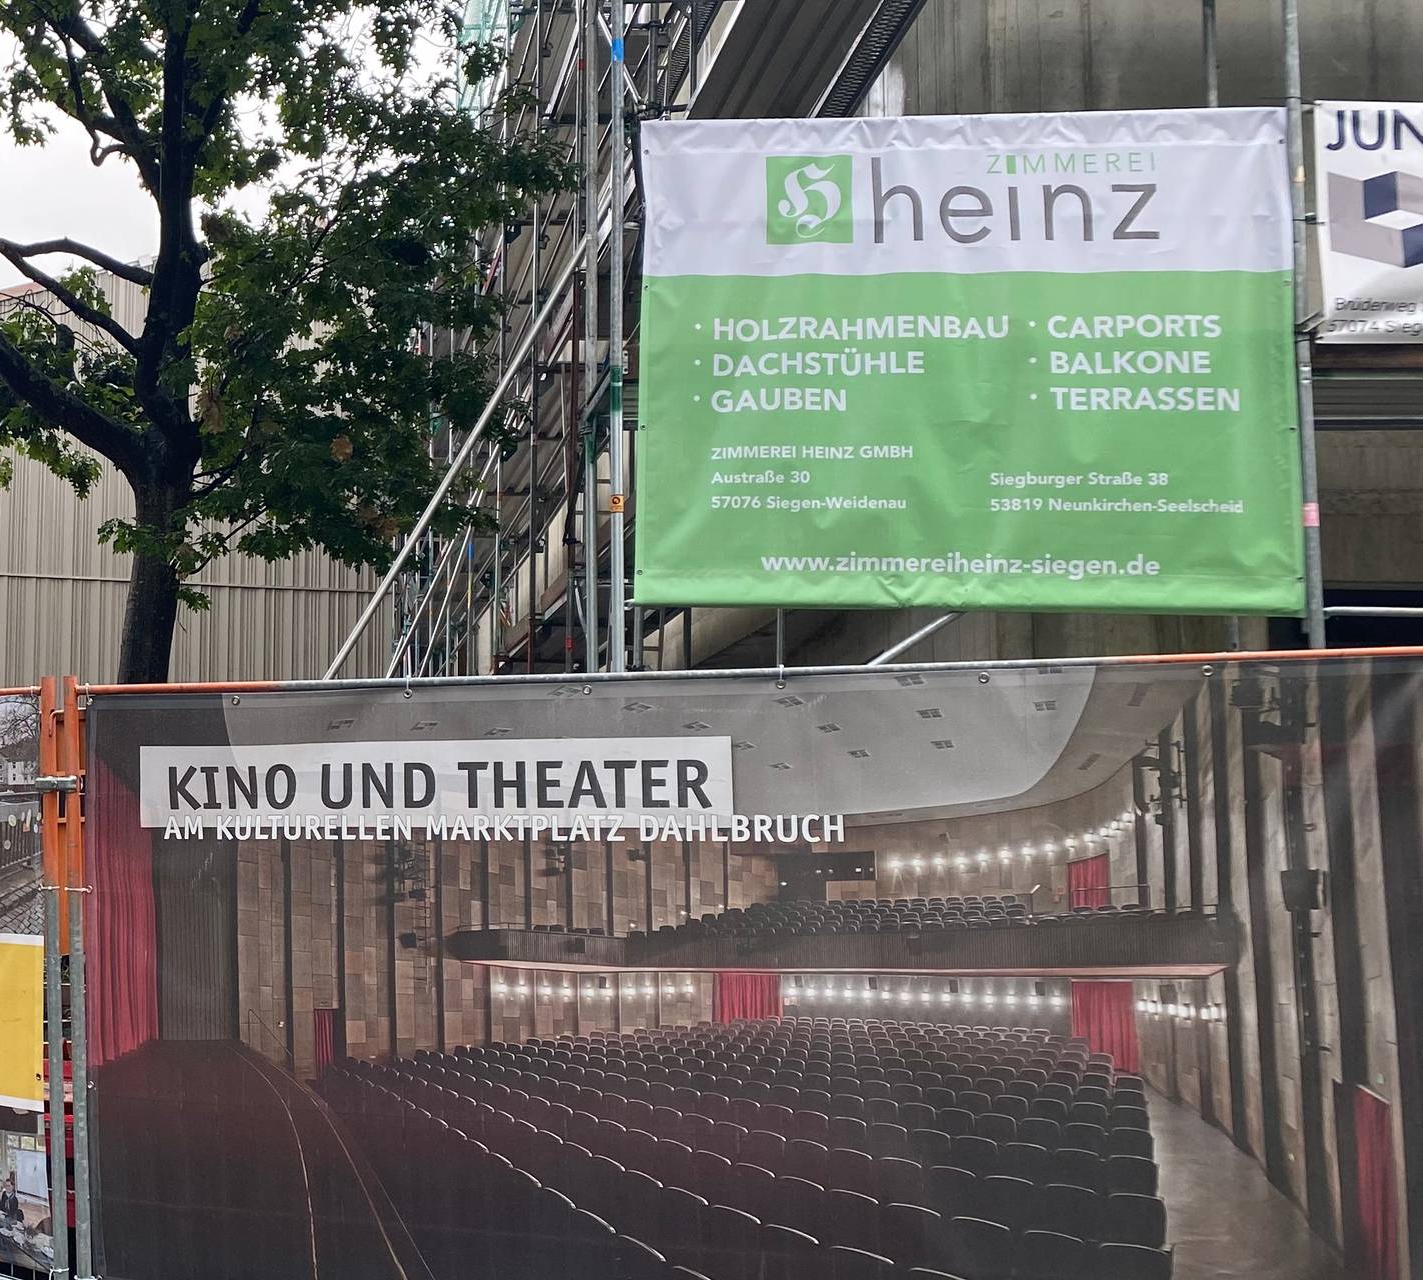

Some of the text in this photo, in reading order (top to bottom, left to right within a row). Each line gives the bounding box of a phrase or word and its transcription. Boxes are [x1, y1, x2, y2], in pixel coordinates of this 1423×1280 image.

[986, 152, 1156, 175] ZIMMEREI
[870, 156, 1161, 244] heinz
[713, 315, 1009, 342] HOLZRAHMENBAU
[1047, 314, 1223, 339] CARPORTS
[713, 347, 925, 377] DACHSTÜHLE
[1050, 350, 1212, 375] BALKONE
[711, 387, 847, 413] GAUBEN
[1049, 386, 1241, 412] TERRASSEN
[710, 445, 914, 460] ZIMMEREI HEINZ GMBH
[710, 470, 811, 484] Austraße 30
[990, 471, 1169, 488] Siegburger Straße 38
[710, 495, 907, 512] 57076 Siegen-Weidenau
[990, 498, 1244, 513] 53819 Neunkirchen-Seelscheid
[760, 551, 1161, 580] www.zimmereiheinz-siegen.de
[168, 758, 713, 811] KINO UND THEATER
[163, 813, 846, 843] AM KULTURELLEN MARKTPLATZ DAHLBRUCH
